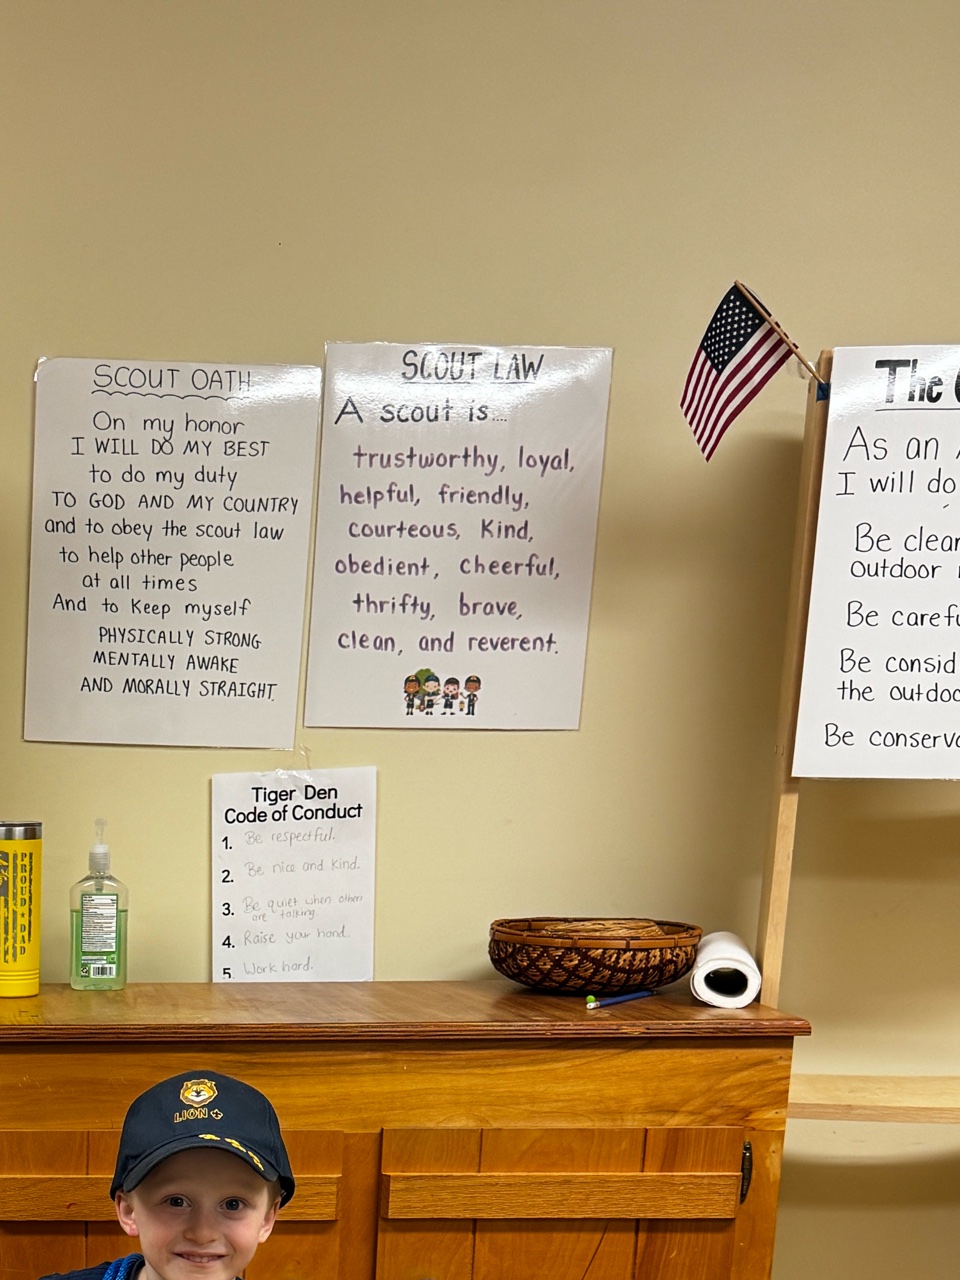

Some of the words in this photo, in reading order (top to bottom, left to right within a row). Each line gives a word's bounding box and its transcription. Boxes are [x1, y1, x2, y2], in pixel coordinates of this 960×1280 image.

[401, 350, 483, 381] SCOUT
[494, 353, 544, 381] LAW
[92, 364, 179, 391] SCOUT
[192, 368, 252, 393] OATH
[875, 359, 944, 404] The
[334, 396, 363, 425] A
[380, 399, 450, 423] scout
[92, 411, 125, 432] On
[142, 417, 175, 441] my
[185, 413, 244, 436] honor
[71, 437, 85, 455] I
[95, 438, 139, 455] WILL
[151, 438, 174, 456] DO
[182, 439, 212, 457] MY
[223, 441, 270, 458] BEST
[843, 426, 888, 461] As
[906, 437, 939, 460] an
[353, 445, 505, 475] trustworthy,
[519, 445, 574, 477] loyal,
[89, 464, 112, 483] to
[122, 464, 145, 484] do
[155, 470, 184, 491] my
[194, 466, 238, 490] duty
[836, 472, 856, 495] I
[870, 469, 914, 494] will
[928, 468, 956, 494] do
[51, 491, 77, 508] TO
[88, 493, 126, 510] GOD
[138, 494, 174, 510] AND
[187, 495, 215, 512] MY
[223, 496, 299, 515] COUNTRY
[340, 482, 420, 509] helpful,
[439, 484, 529, 511] friendly,
[44, 518, 76, 535] and
[85, 519, 104, 535] to
[111, 520, 153, 541] obey
[161, 521, 188, 538] the
[195, 523, 241, 539] scout
[253, 522, 284, 541] law
[349, 520, 460, 540] courteous,
[855, 522, 892, 552] Be
[59, 547, 79, 564] to
[88, 546, 124, 569] help
[130, 549, 173, 567] other
[179, 551, 235, 572] people
[335, 553, 439, 579] obedient,
[460, 554, 559, 579] cheerful,
[851, 557, 941, 579] outdoor
[82, 572, 101, 589] at
[110, 573, 130, 590] all
[142, 575, 198, 592] times
[52, 594, 87, 612] And
[102, 597, 119, 613] to
[131, 598, 171, 617] Keep
[185, 598, 252, 621] myself
[353, 593, 435, 620] thrifty,
[459, 592, 522, 619] brave,
[847, 601, 879, 627] Be
[99, 626, 194, 647] PHYSICALLY
[205, 630, 262, 650] STRONG
[338, 630, 403, 656] clean,
[419, 633, 454, 653] and
[469, 636, 558, 654] reverent.
[93, 651, 175, 669] MENTALLY
[186, 655, 239, 674] AWAKE
[840, 648, 872, 673] Be
[885, 647, 955, 674] consid
[81, 677, 113, 693] AND
[123, 679, 191, 696] MORALLY
[199, 681, 278, 701] STRAIGHT.
[837, 680, 875, 702] the
[825, 723, 855, 748] Be
[252, 787, 296, 806] Tiger
[305, 785, 338, 800] Den
[225, 806, 267, 824] Code
[272, 805, 288, 822] of
[292, 803, 363, 821] Conduct
[222, 836, 233, 850] 1.
[245, 831, 263, 845] Be
[271, 827, 336, 847] respectful.
[221, 870, 234, 883] 2.
[244, 862, 265, 876] Be
[272, 861, 295, 873] nice
[303, 859, 324, 871] and
[222, 903, 234, 916] 3.
[243, 896, 260, 913] Be
[268, 898, 298, 913] quiet
[305, 895, 332, 905] when
[252, 912, 267, 922] are
[222, 936, 235, 948] 4.
[244, 930, 276, 946] Raise
[285, 931, 310, 944] your
[244, 962, 277, 975] Work
[282, 957, 313, 971] hard.
[174, 1108, 208, 1123] LION
